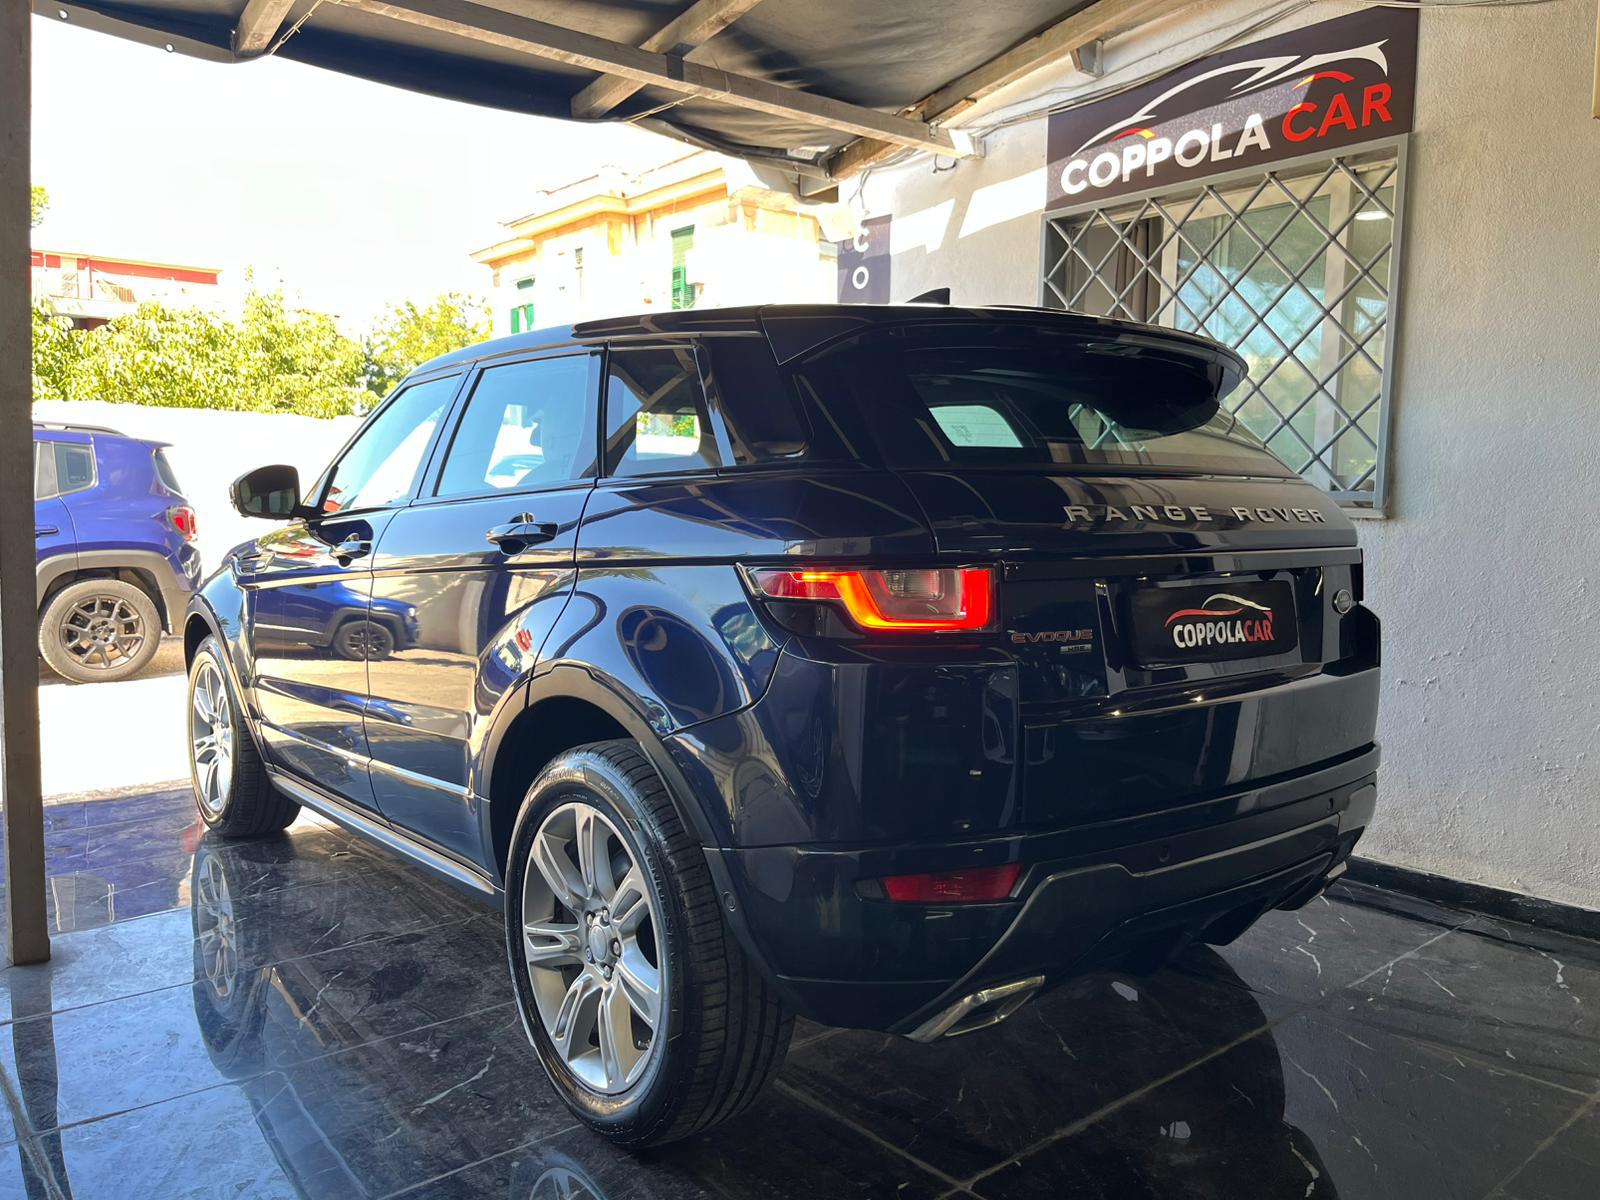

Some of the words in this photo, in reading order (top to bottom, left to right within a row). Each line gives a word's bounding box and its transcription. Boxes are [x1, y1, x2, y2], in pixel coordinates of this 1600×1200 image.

[1060, 113, 1271, 196] COPPOLA
[1281, 83, 1393, 143] CAR
[1063, 505, 1213, 522] RANGE
[1231, 506, 1326, 524] ROVER
[1010, 628, 1094, 644] EVOQUE
